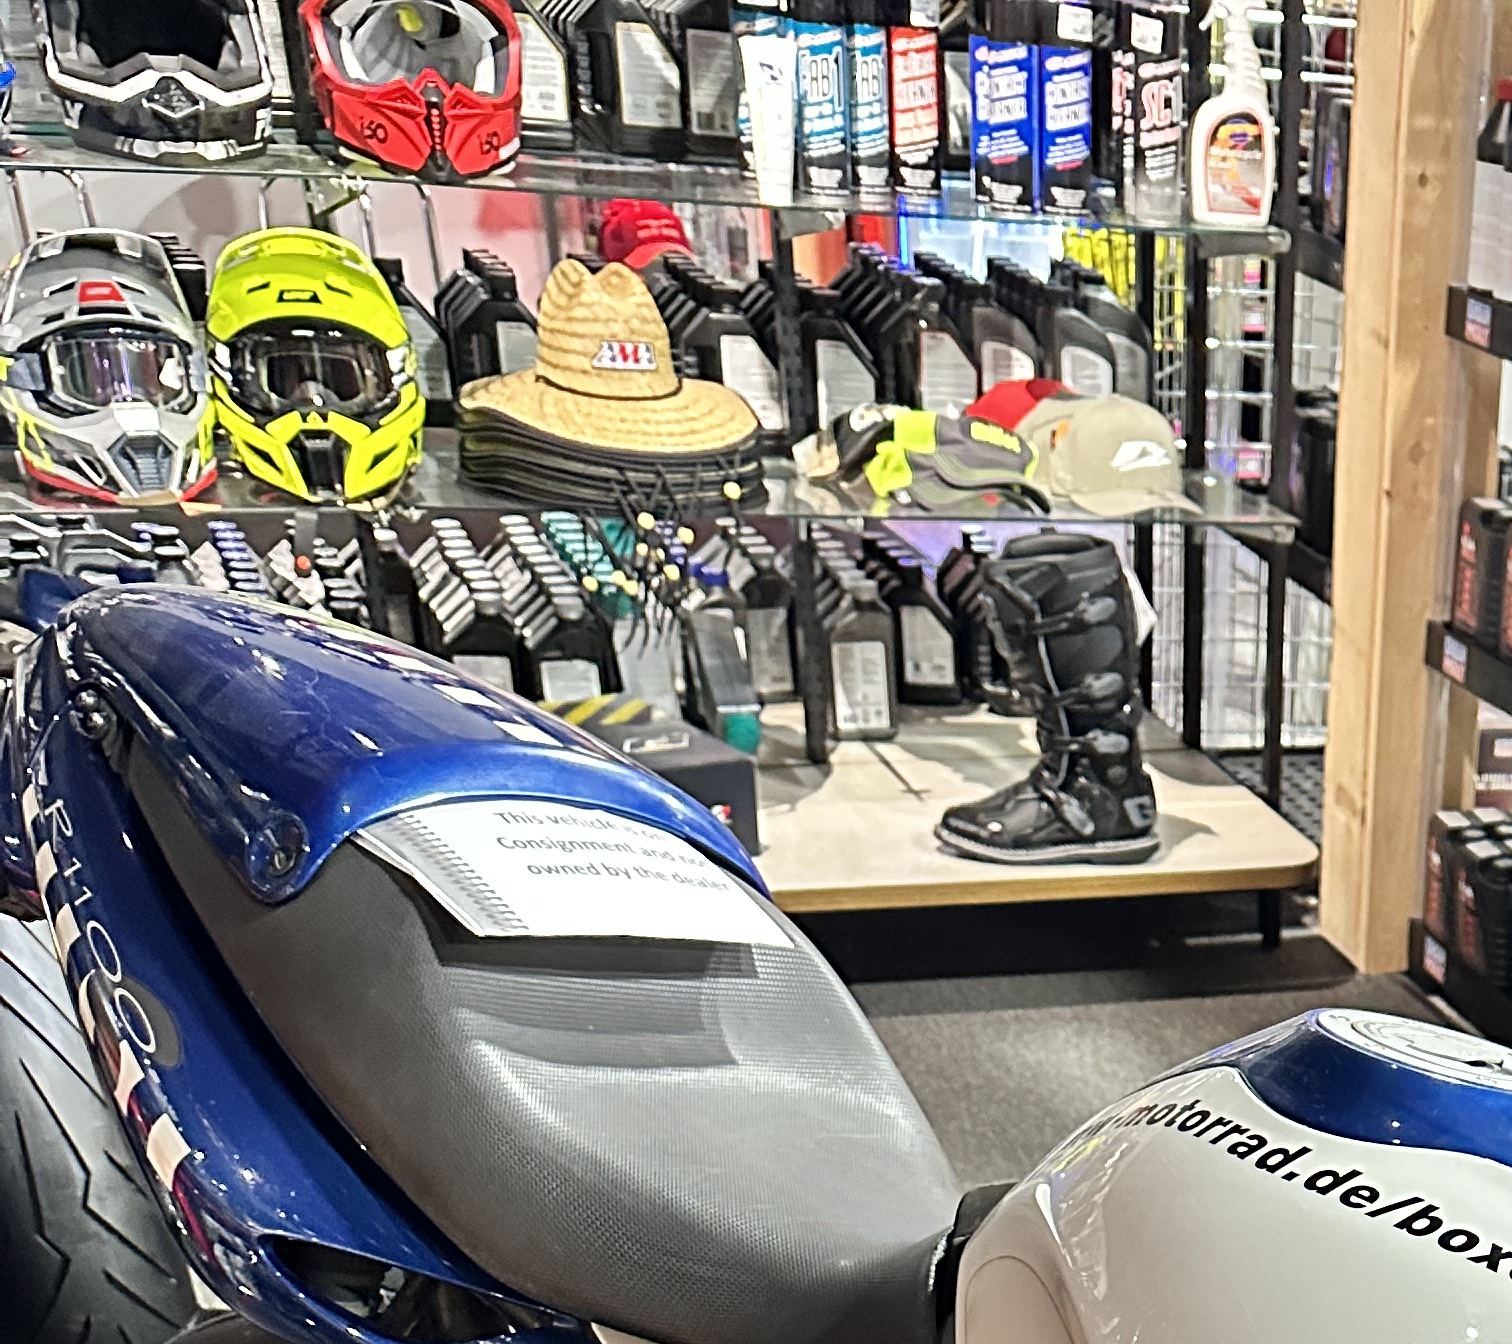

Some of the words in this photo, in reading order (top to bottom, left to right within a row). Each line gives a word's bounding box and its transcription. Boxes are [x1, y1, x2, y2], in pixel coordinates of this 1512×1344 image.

[493, 811, 543, 825] This
[543, 815, 619, 831] vehicle
[623, 824, 638, 836] is
[641, 828, 666, 842] on
[496, 837, 635, 853] Consignment
[642, 847, 676, 862] and
[527, 861, 601, 877] owned
[601, 862, 632, 880] by
[633, 865, 666, 882] the
[671, 871, 731, 892] dealer
